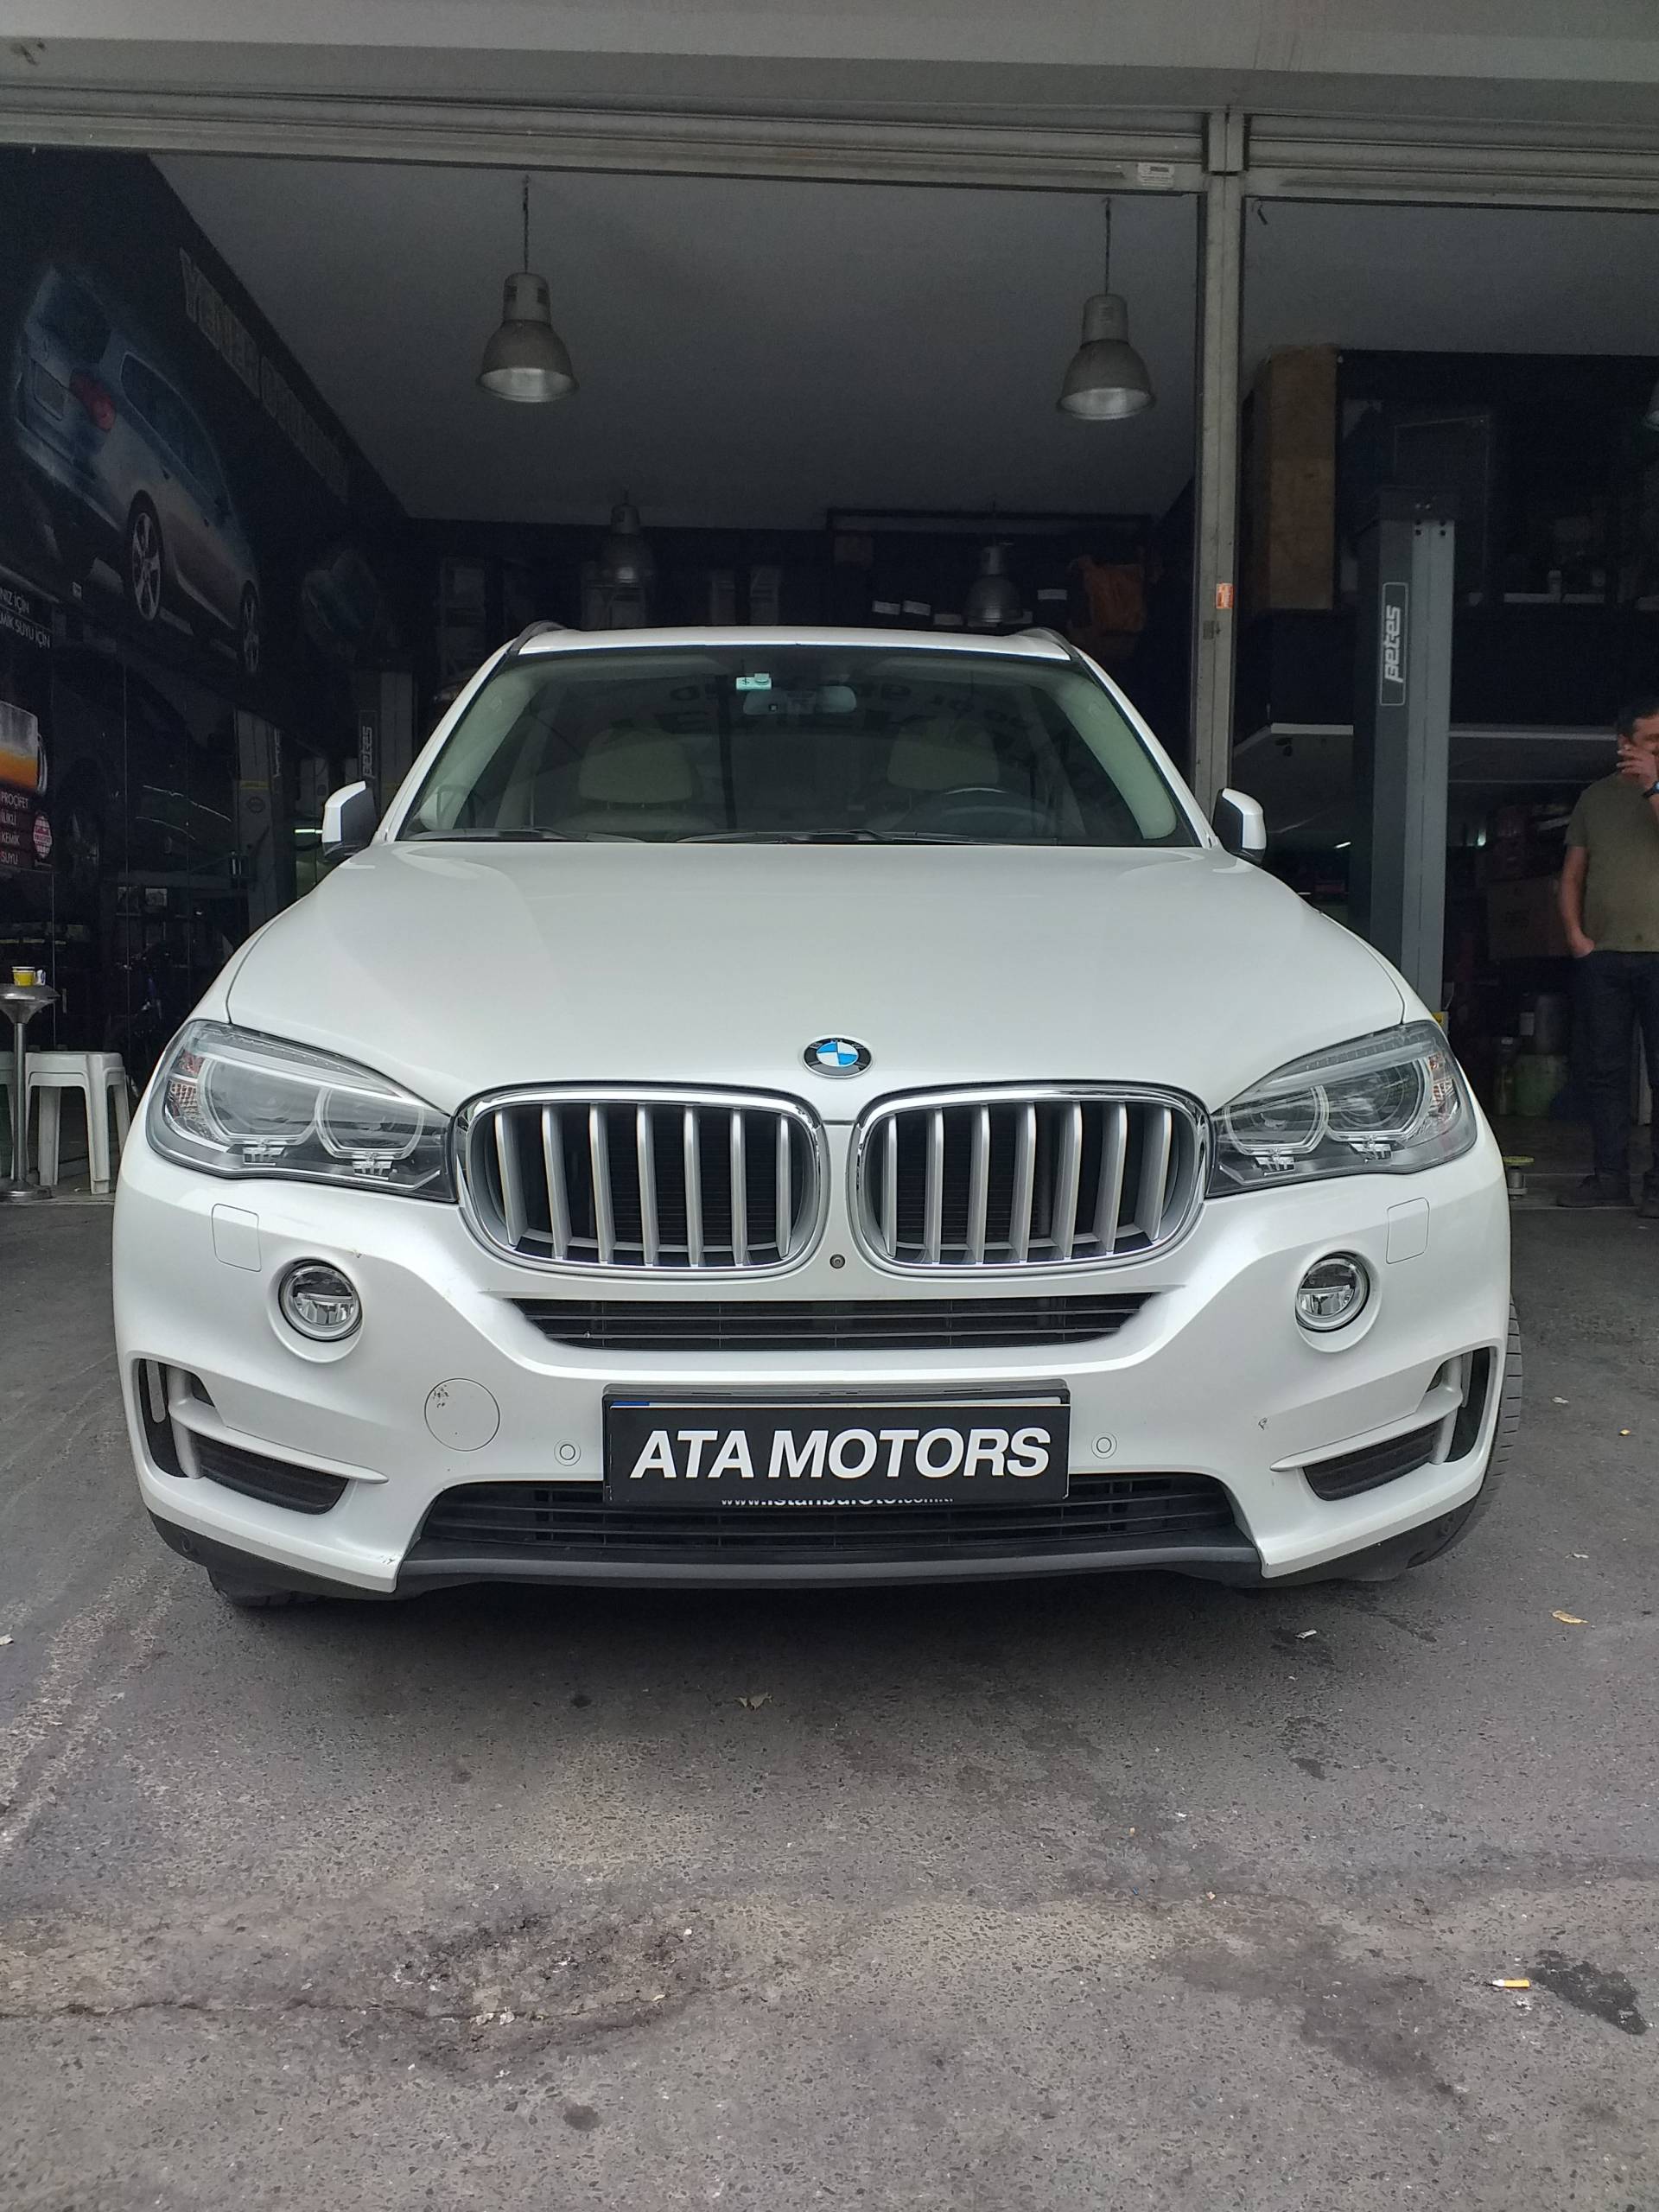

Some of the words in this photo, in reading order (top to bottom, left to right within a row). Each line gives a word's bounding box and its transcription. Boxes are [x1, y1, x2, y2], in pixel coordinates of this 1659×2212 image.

[1383, 604, 1403, 683] petes
[629, 1429, 755, 1478] ATA
[767, 1427, 1051, 1478] MOTORS
